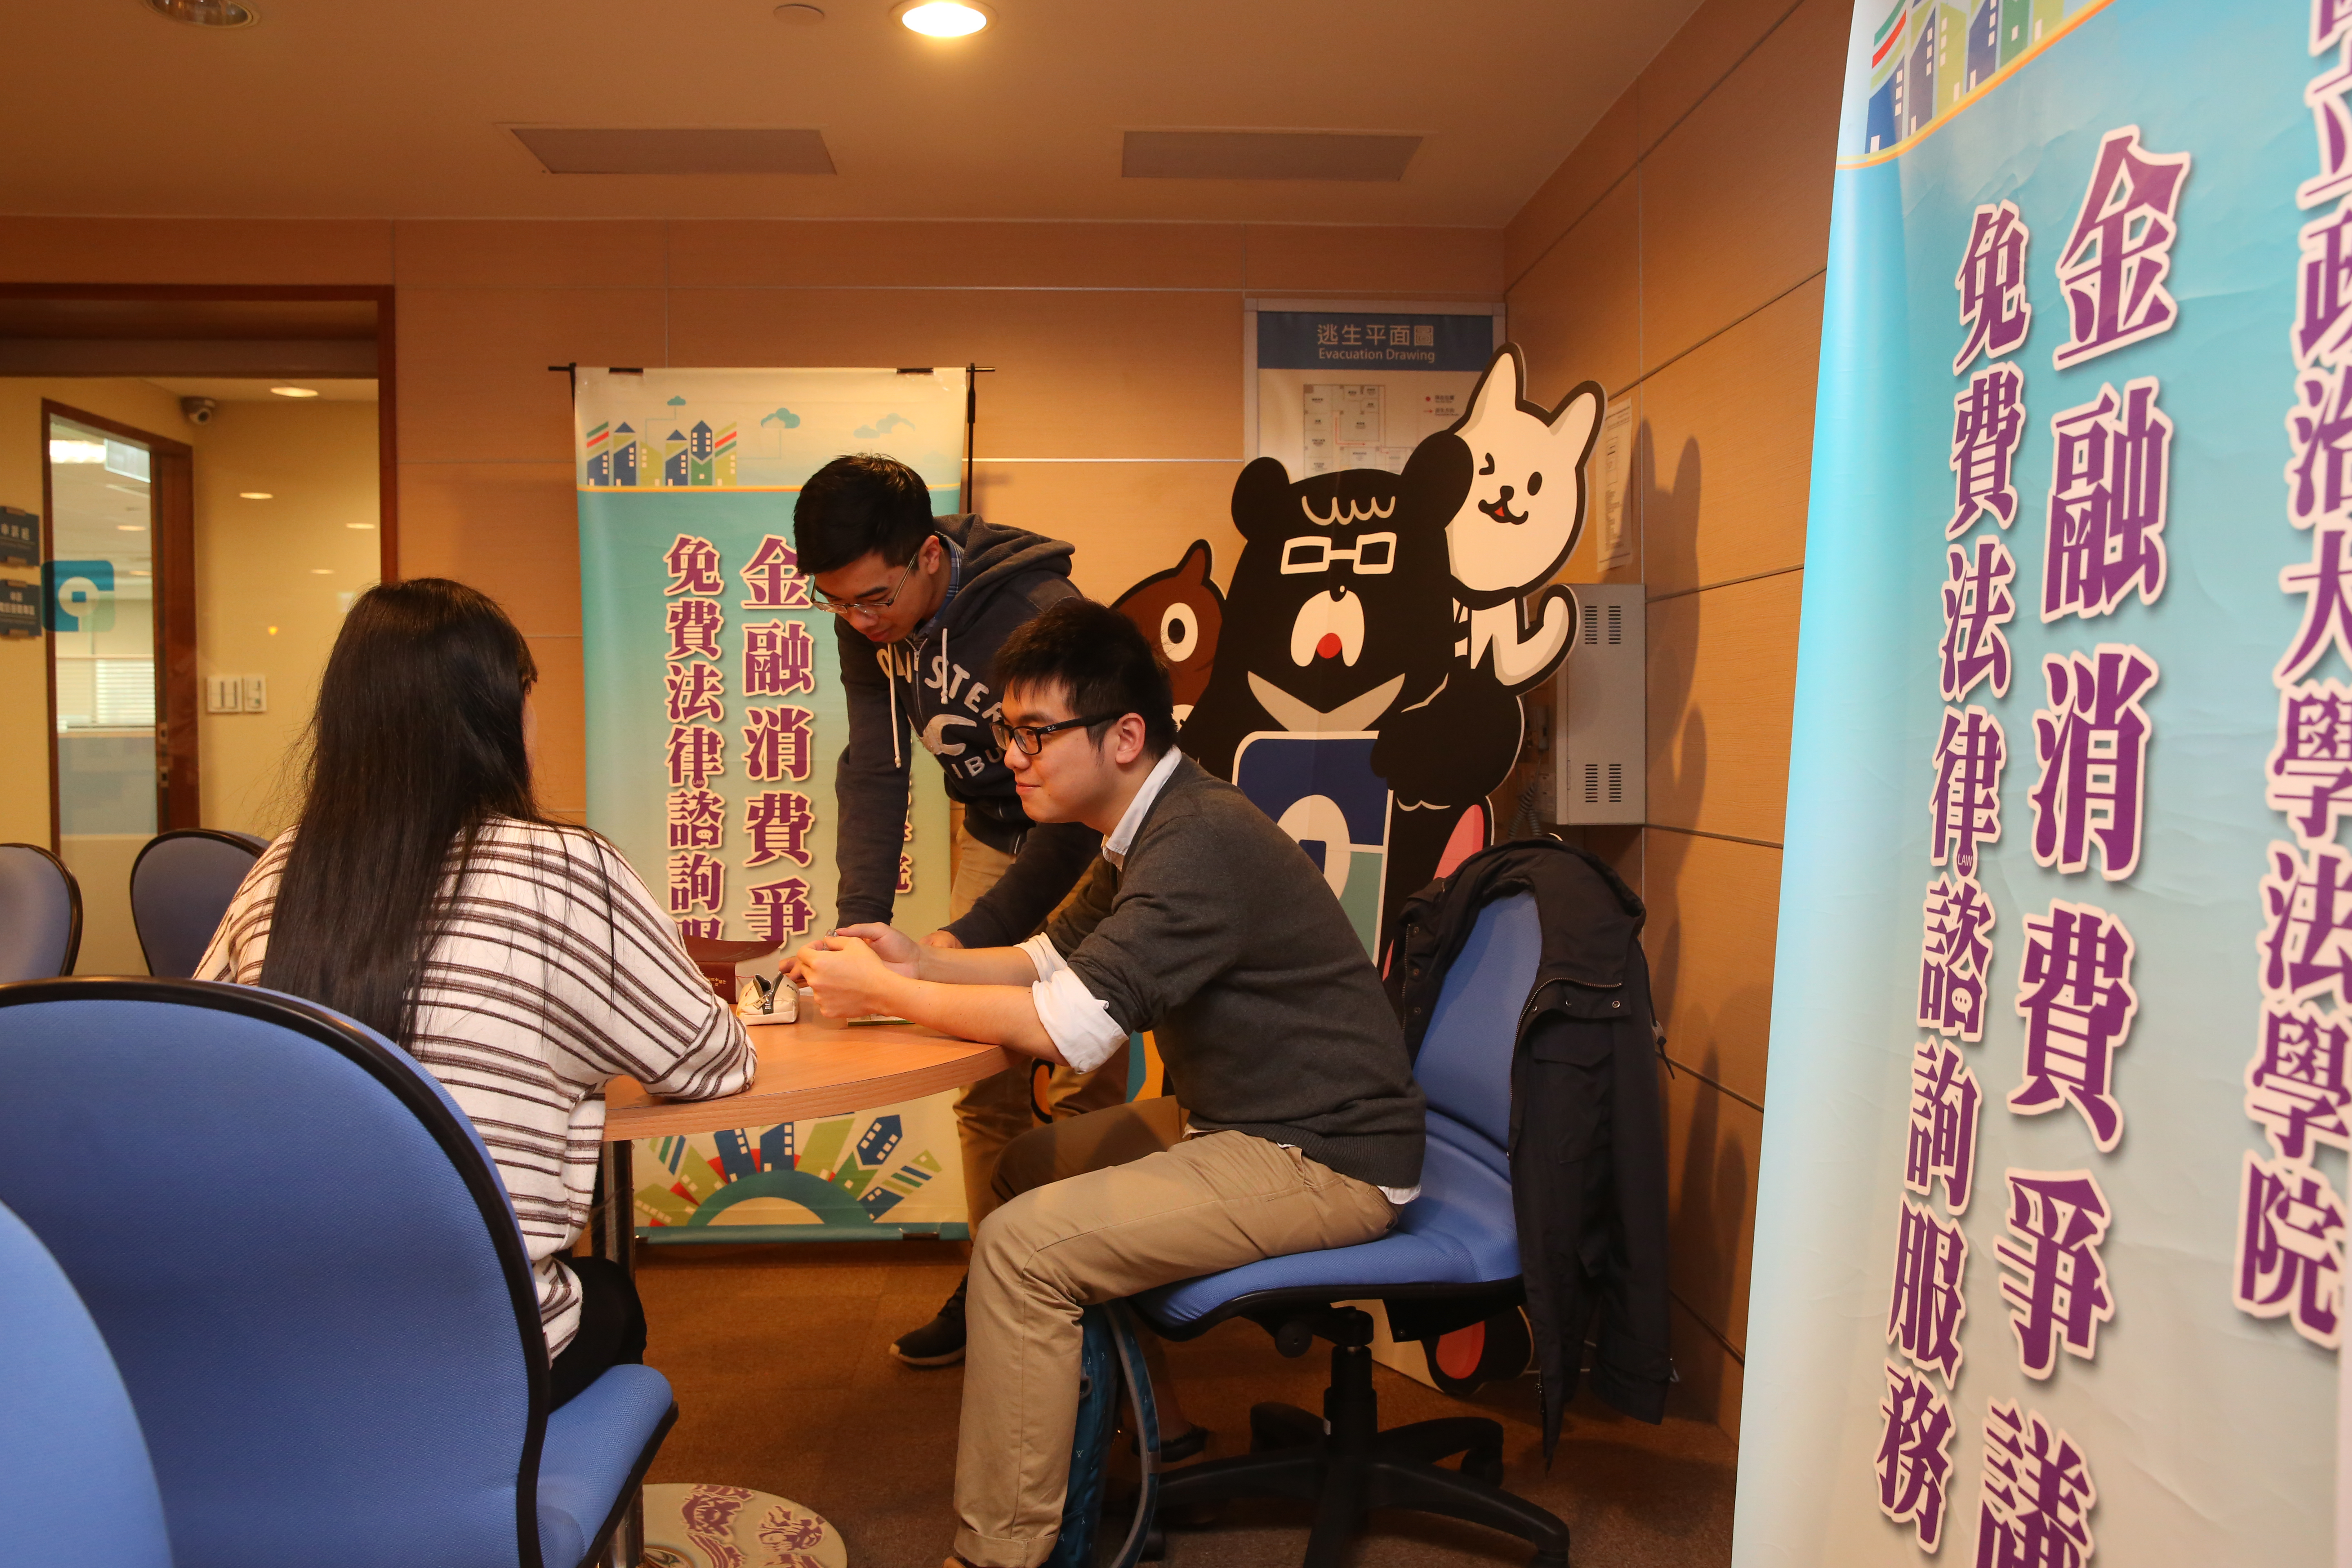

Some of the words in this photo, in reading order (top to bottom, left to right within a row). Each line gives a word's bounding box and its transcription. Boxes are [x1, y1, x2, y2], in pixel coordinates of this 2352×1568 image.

[1318, 324, 1434, 346] 逃生平面圖
[1319, 347, 1383, 360] Evacuation
[1386, 349, 1435, 363] Drawing
[2241, 0, 2352, 1335] 政治大學法學院
[1876, 206, 2025, 1545] 免費法律諮詢服務
[1958, 853, 1973, 867] LAW
[1976, 134, 2186, 1568] 金融消費爭議
